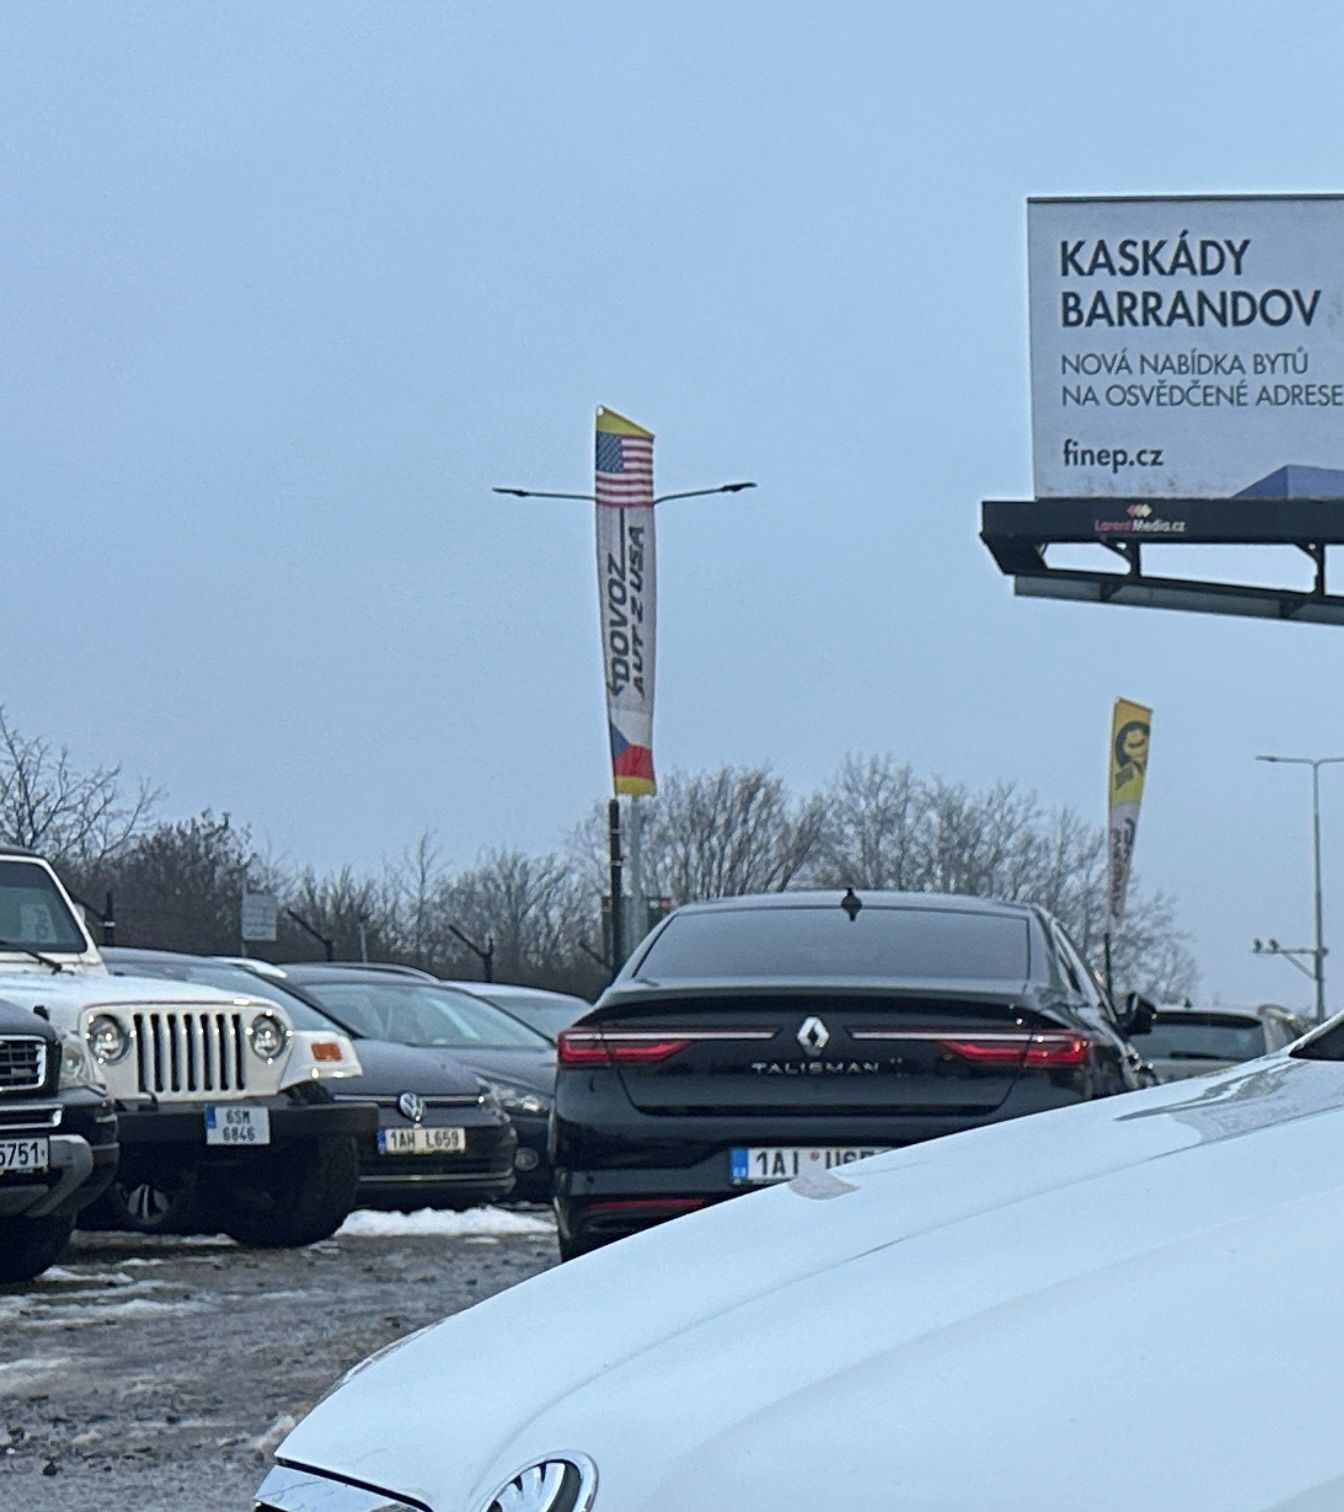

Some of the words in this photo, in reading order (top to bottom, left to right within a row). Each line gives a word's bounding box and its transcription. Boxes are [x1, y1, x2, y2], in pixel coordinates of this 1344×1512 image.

[1059, 228, 1252, 278] KASKÁDY
[1060, 288, 1323, 328] BARRANDOV
[1060, 346, 1133, 376] NOVÁ
[1139, 346, 1247, 376] NABÍDKA
[1252, 345, 1310, 376] BYTŮ
[1061, 384, 1101, 407] NA
[1104, 378, 1250, 408] OSVĚDČENÉ
[1254, 383, 1344, 408] ADRESE
[1062, 437, 1166, 475] finep.cz
[629, 526, 646, 594] USA
[607, 551, 632, 684] DOVOZ
[751, 1061, 880, 1075] TALISMAN
